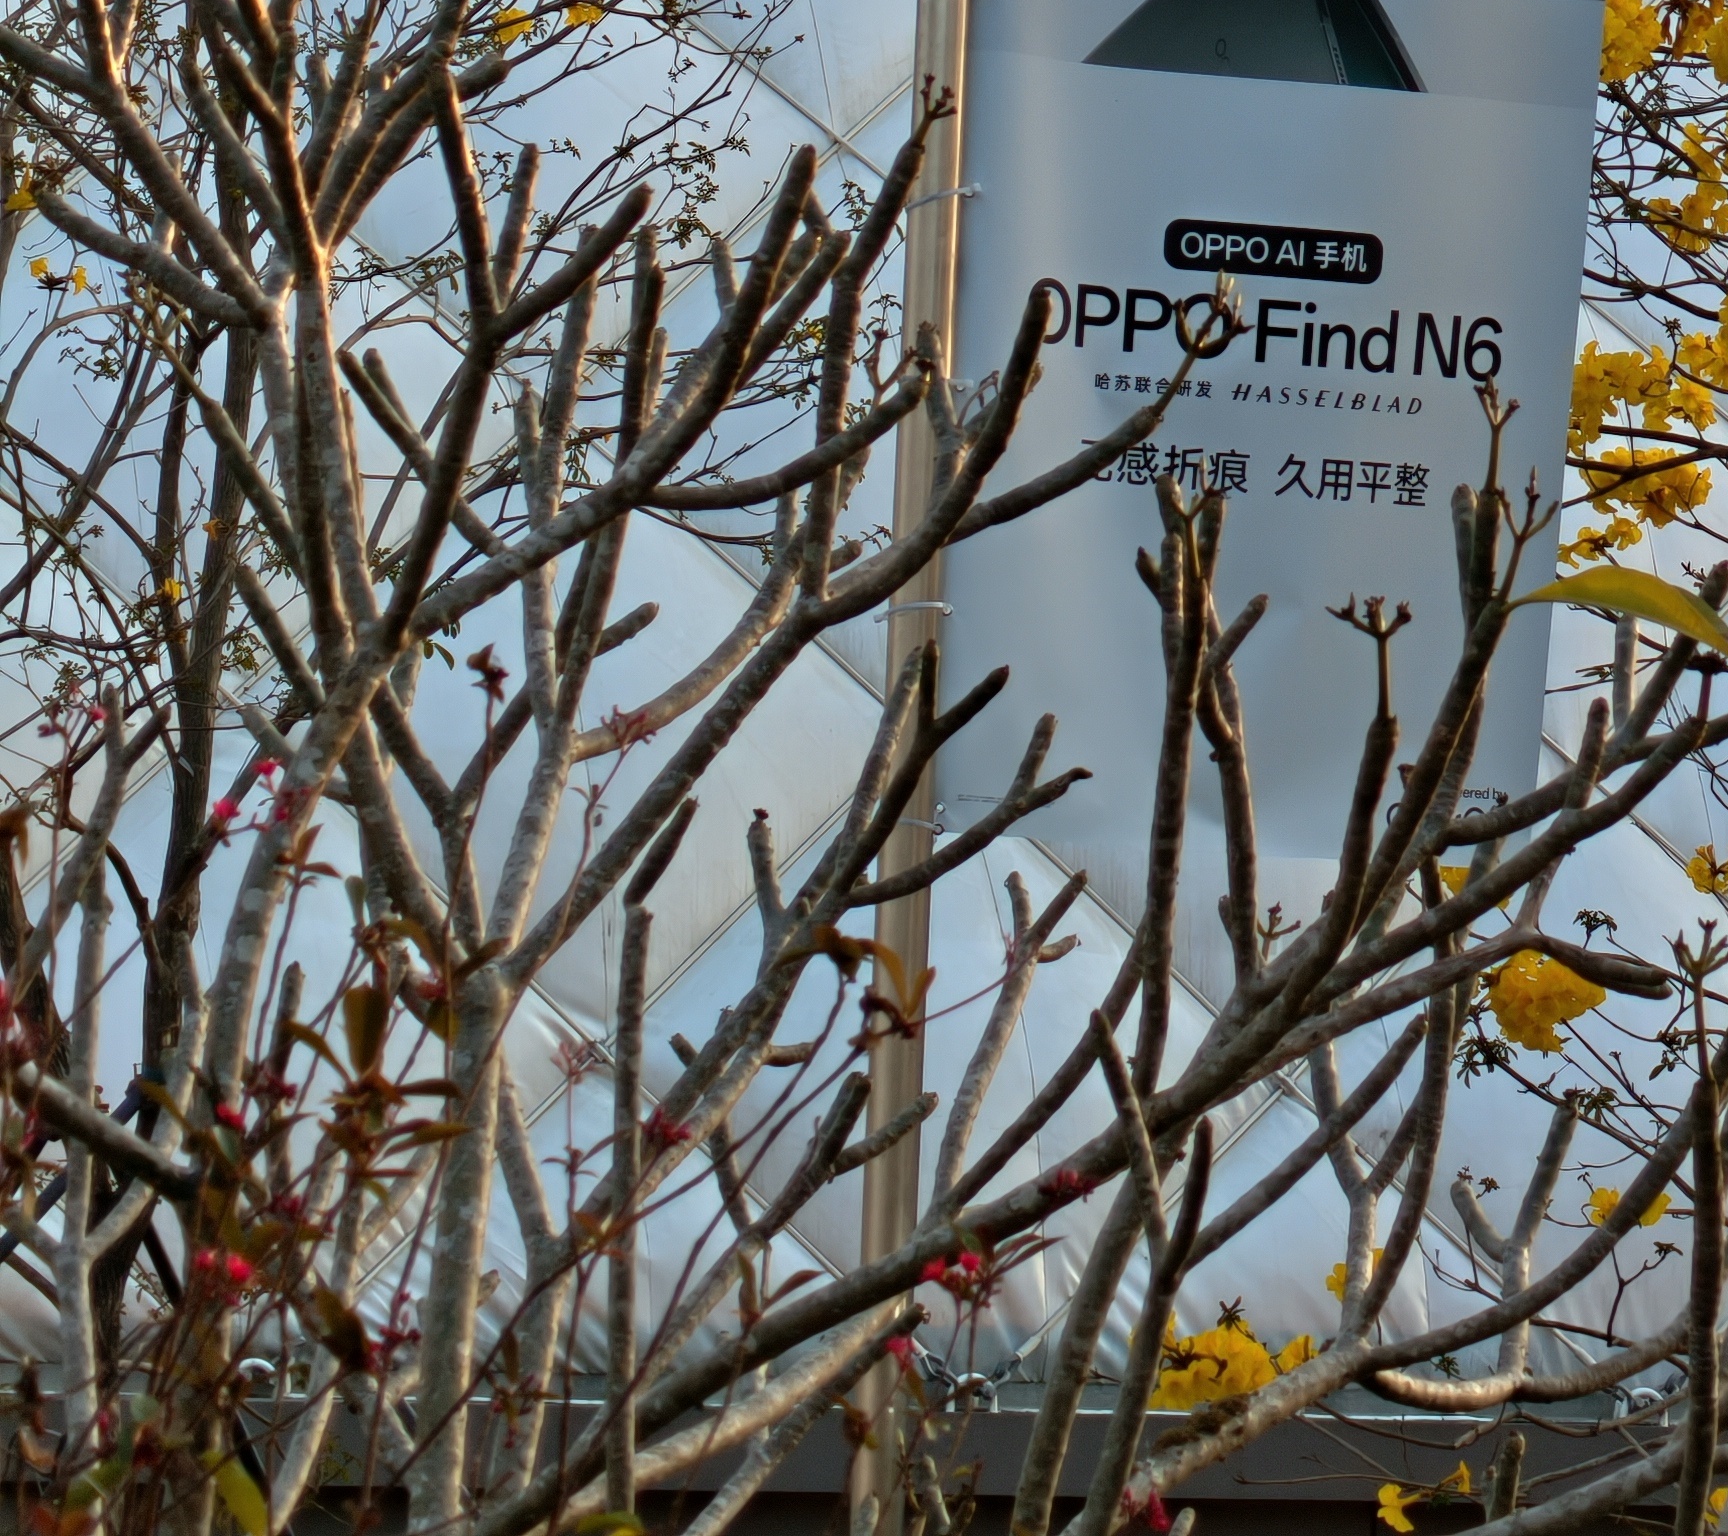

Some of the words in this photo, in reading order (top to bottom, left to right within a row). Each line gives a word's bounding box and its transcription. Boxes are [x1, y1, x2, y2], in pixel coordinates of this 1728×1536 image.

[1180, 231, 1270, 264] OPPO
[1275, 240, 1305, 267] AI
[1313, 241, 1368, 273] 手机
[1255, 299, 1400, 374] Find
[1412, 312, 1503, 383] N6
[1094, 372, 1213, 399] 哈苏联合研发
[1230, 383, 1423, 415] HASSELBLAD
[1274, 453, 1430, 507] 久用平整
